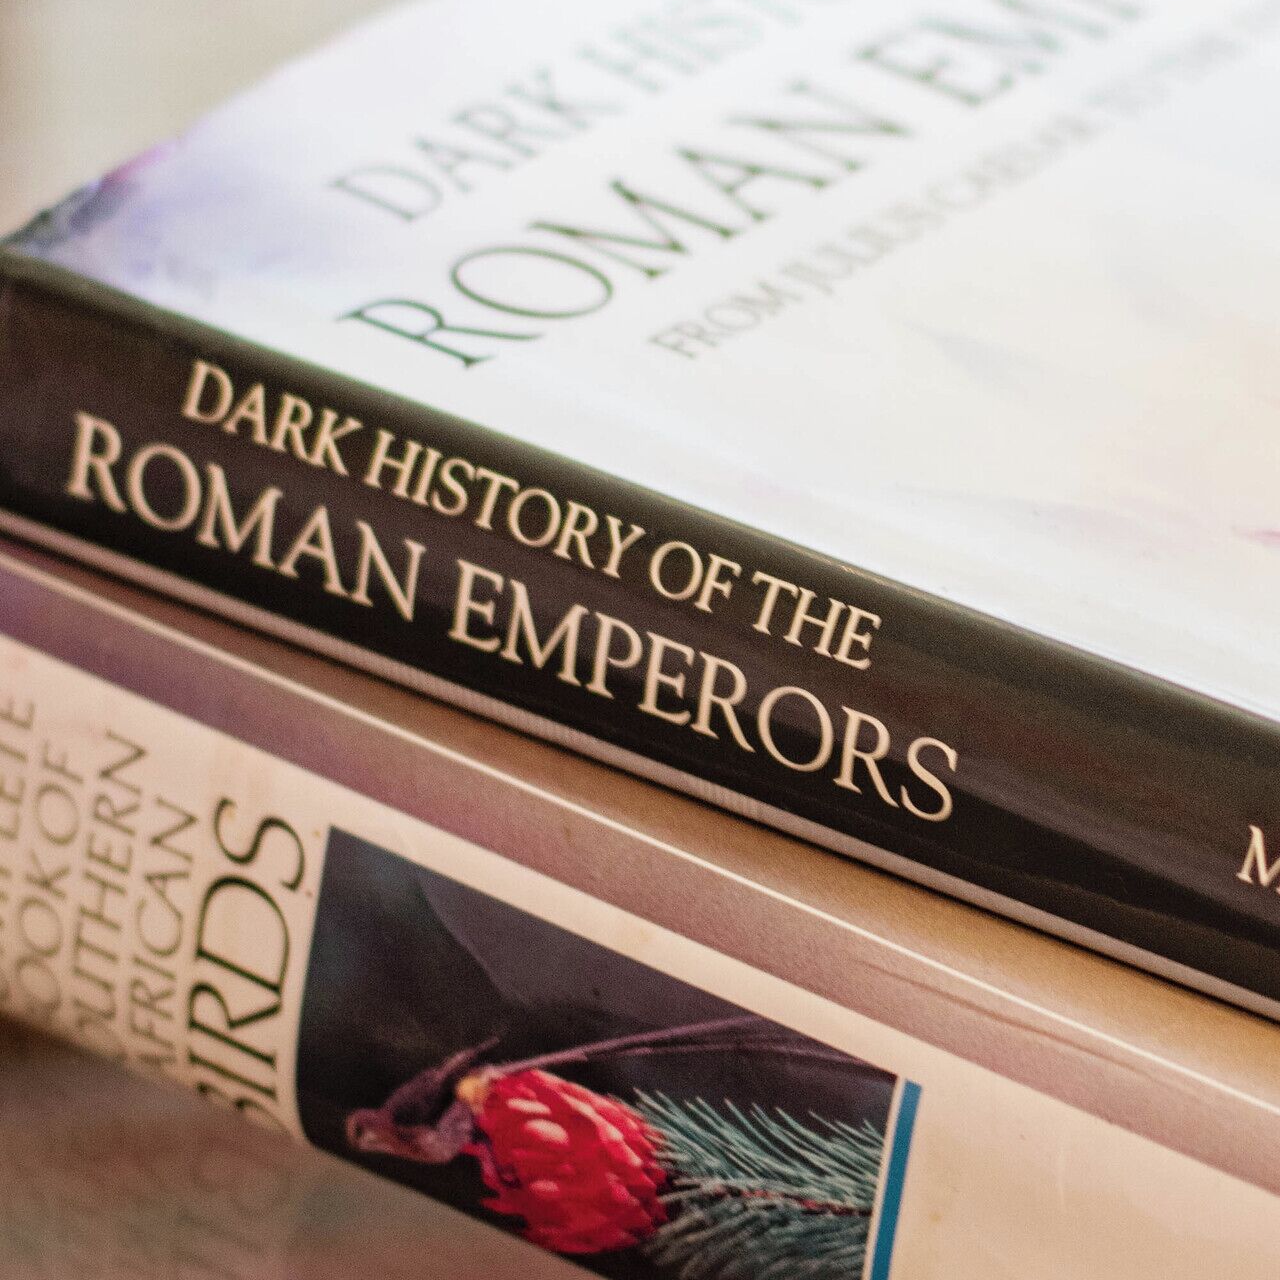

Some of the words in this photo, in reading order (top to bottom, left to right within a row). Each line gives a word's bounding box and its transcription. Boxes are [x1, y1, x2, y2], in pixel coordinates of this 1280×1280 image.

[327, 64, 624, 223] DARK
[338, 76, 914, 370] ROMAN
[647, 280, 803, 361] FROM
[66, 412, 426, 622] ROMAN
[448, 559, 959, 823] EMPERORS
[183, 360, 363, 477] DARK
[364, 430, 646, 579] HISTORY
[650, 541, 742, 613] OF
[752, 572, 882, 670] THE
[11, 848, 71, 1025] OOK
[72, 727, 148, 1048] UTHERN
